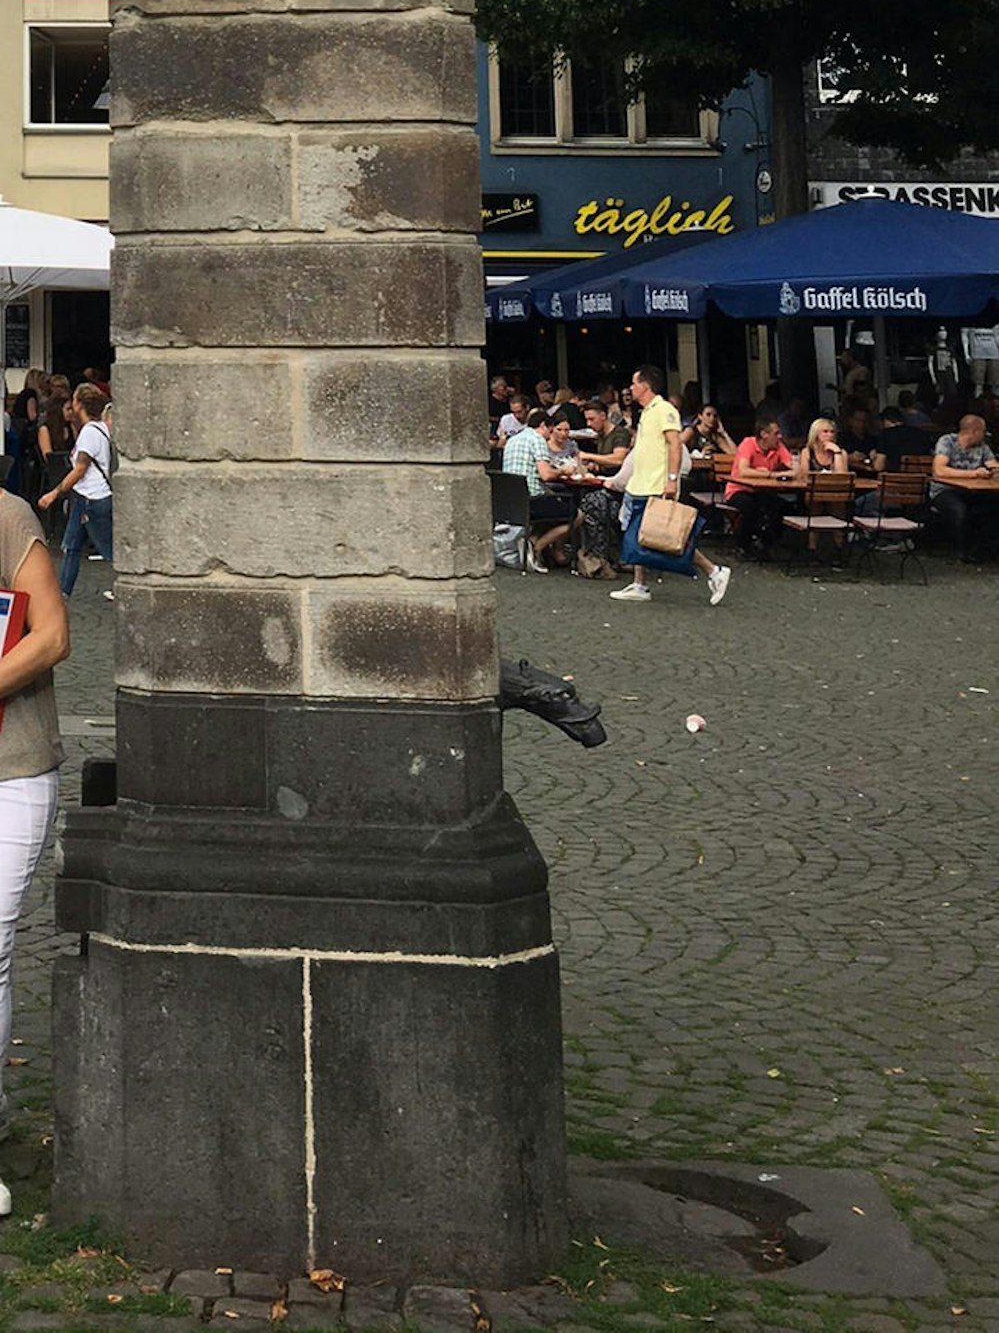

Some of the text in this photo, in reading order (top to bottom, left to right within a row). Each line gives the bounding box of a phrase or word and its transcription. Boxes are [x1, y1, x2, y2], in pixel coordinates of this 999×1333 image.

[573, 195, 735, 248] täglich
[803, 287, 926, 311] Gaffel Kölsch
